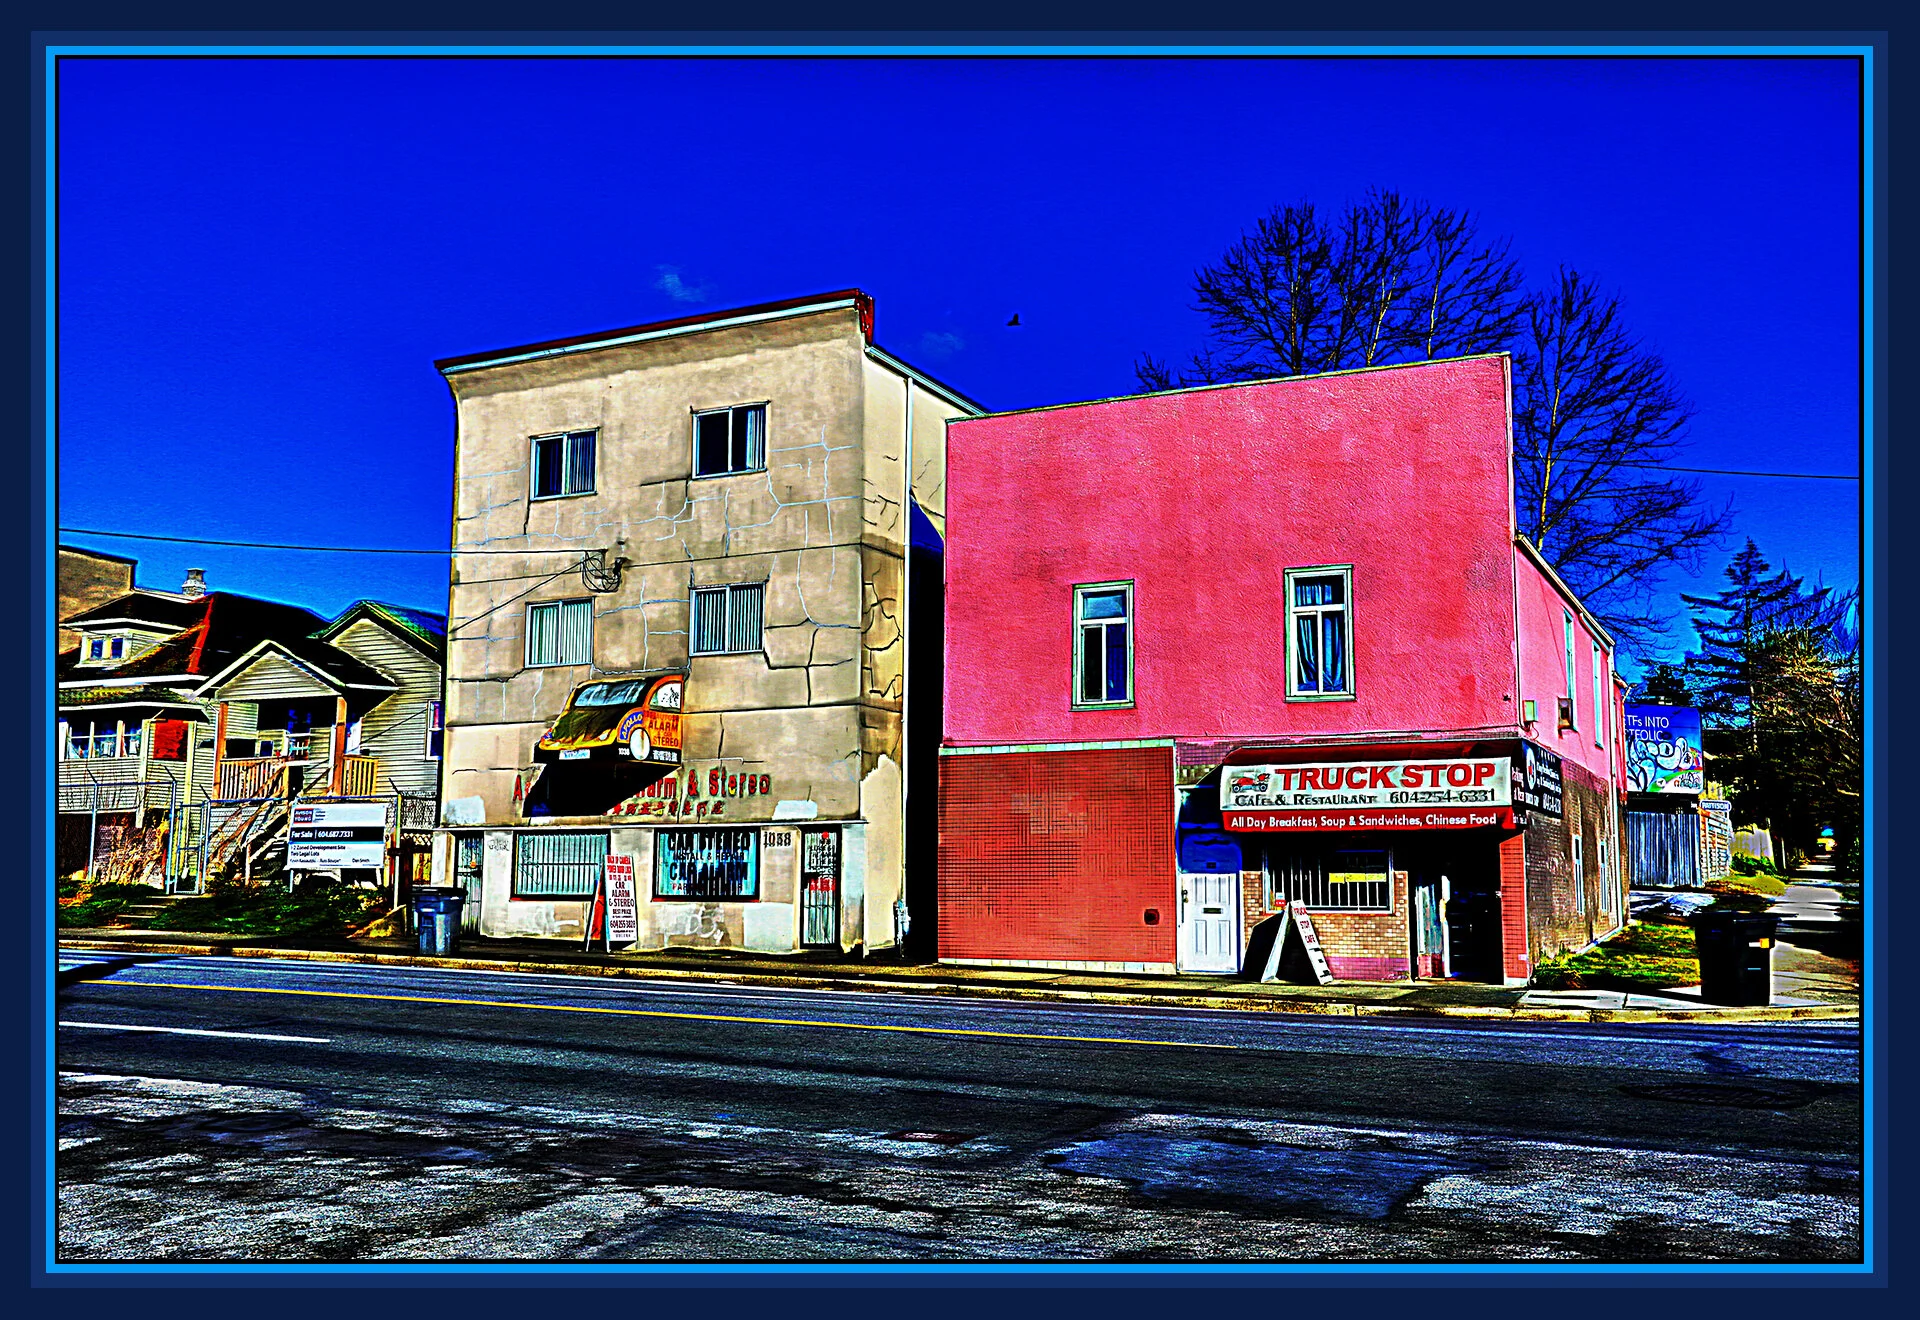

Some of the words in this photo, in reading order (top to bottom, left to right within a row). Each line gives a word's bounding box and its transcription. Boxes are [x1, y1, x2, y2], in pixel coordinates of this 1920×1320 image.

[622, 714, 643, 740] APOLLO
[648, 719, 679, 733] ALARM
[1644, 716, 1669, 729] INTO
[653, 737, 679, 747] STEREO
[688, 769, 699, 797] &
[708, 767, 770, 798] Stereo
[1275, 765, 1396, 791] TRUCK
[1400, 763, 1496, 788] STOP
[1274, 794, 1289, 806] &
[1390, 788, 1496, 804] 604-254-6331
[1231, 816, 1244, 827] All
[1246, 817, 1267, 830] Day
[1269, 815, 1318, 828] Breakfast,
[1320, 815, 1346, 828] Soup
[1348, 815, 1356, 826] &
[1358, 814, 1423, 827] Sandwiches,
[1425, 814, 1467, 825] Chinese
[1469, 813, 1496, 825] Food
[615, 881, 625, 889] CAR
[614, 899, 634, 907] STEREO
